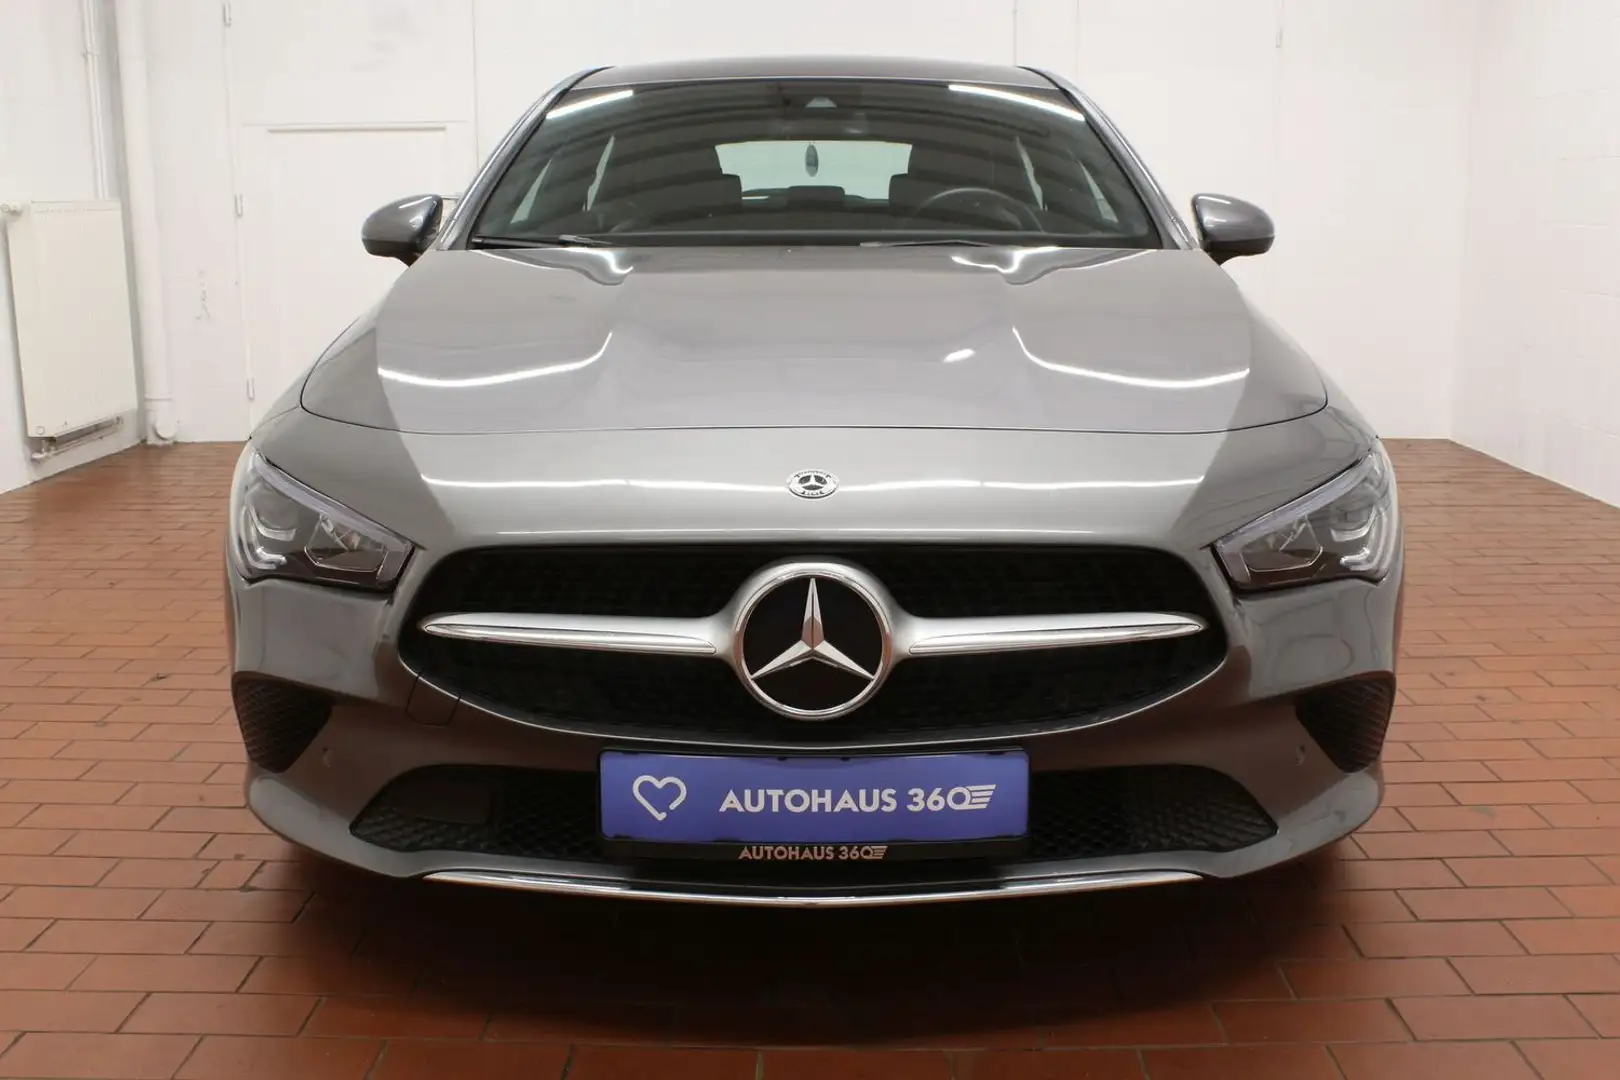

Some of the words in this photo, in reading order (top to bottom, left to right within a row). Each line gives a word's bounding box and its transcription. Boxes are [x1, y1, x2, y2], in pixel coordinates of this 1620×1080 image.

[719, 788, 897, 813] AUTOHAUS
[906, 784, 997, 812] 360
[738, 846, 834, 860] AUTOHAUS
